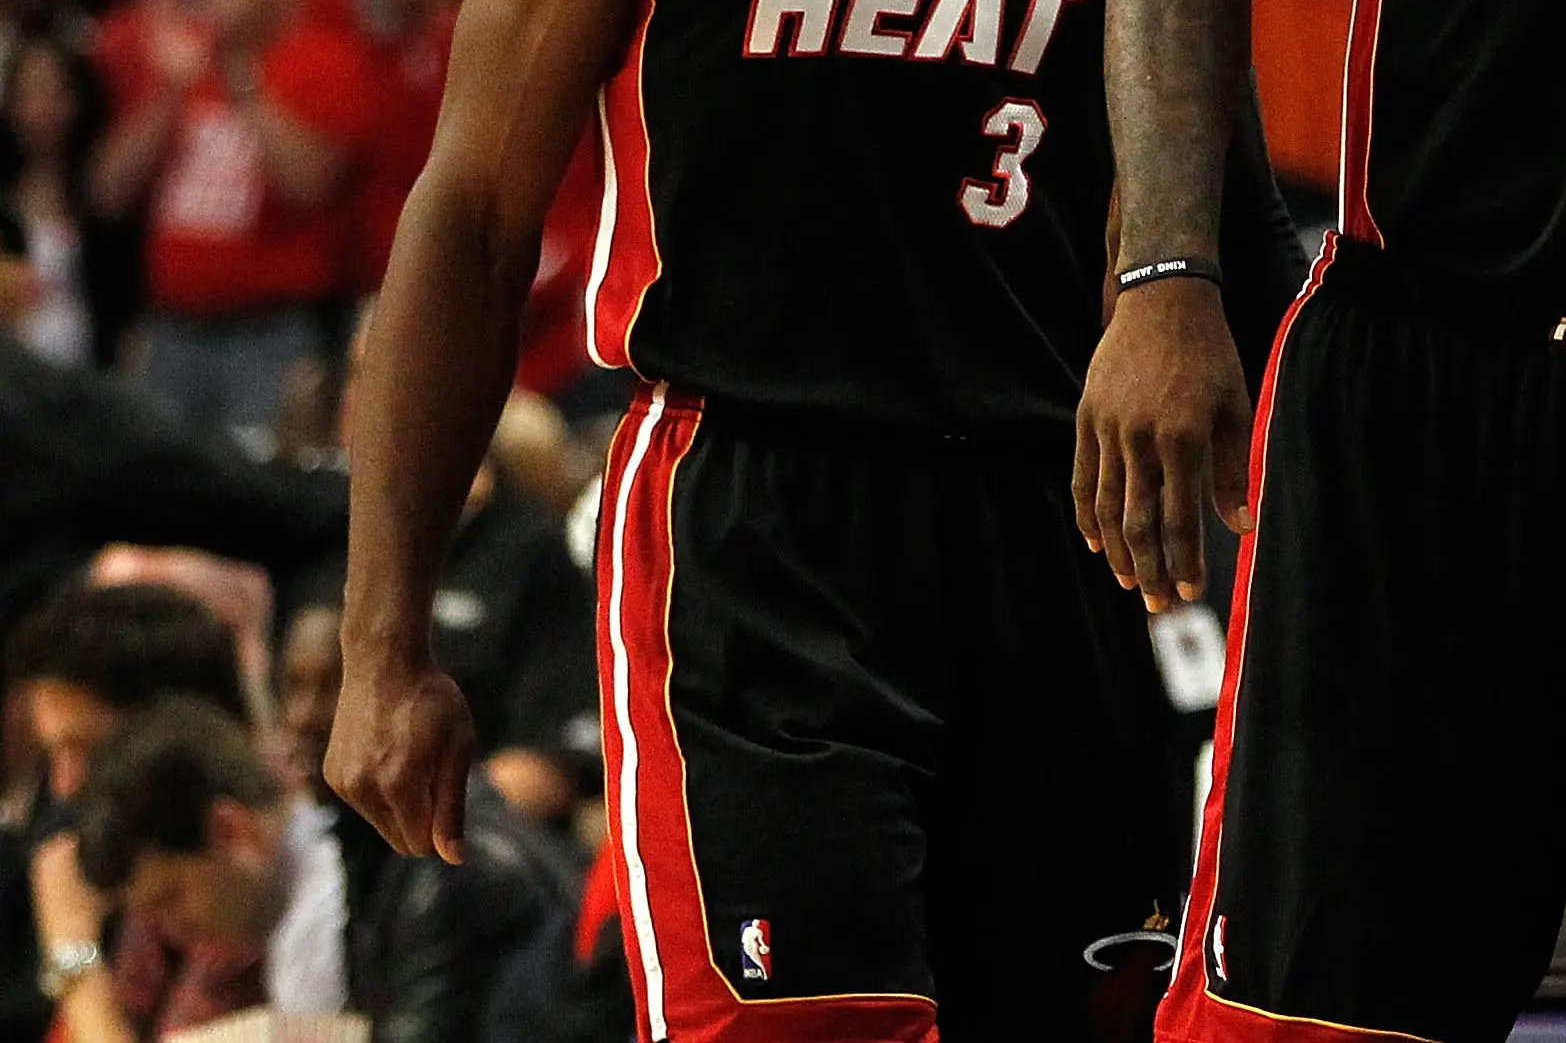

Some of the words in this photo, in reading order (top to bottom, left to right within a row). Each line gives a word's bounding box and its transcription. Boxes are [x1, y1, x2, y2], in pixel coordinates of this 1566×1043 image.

[957, 96, 1048, 227] 3
[1120, 265, 1154, 284] JAMES
[1156, 260, 1187, 273] KING
